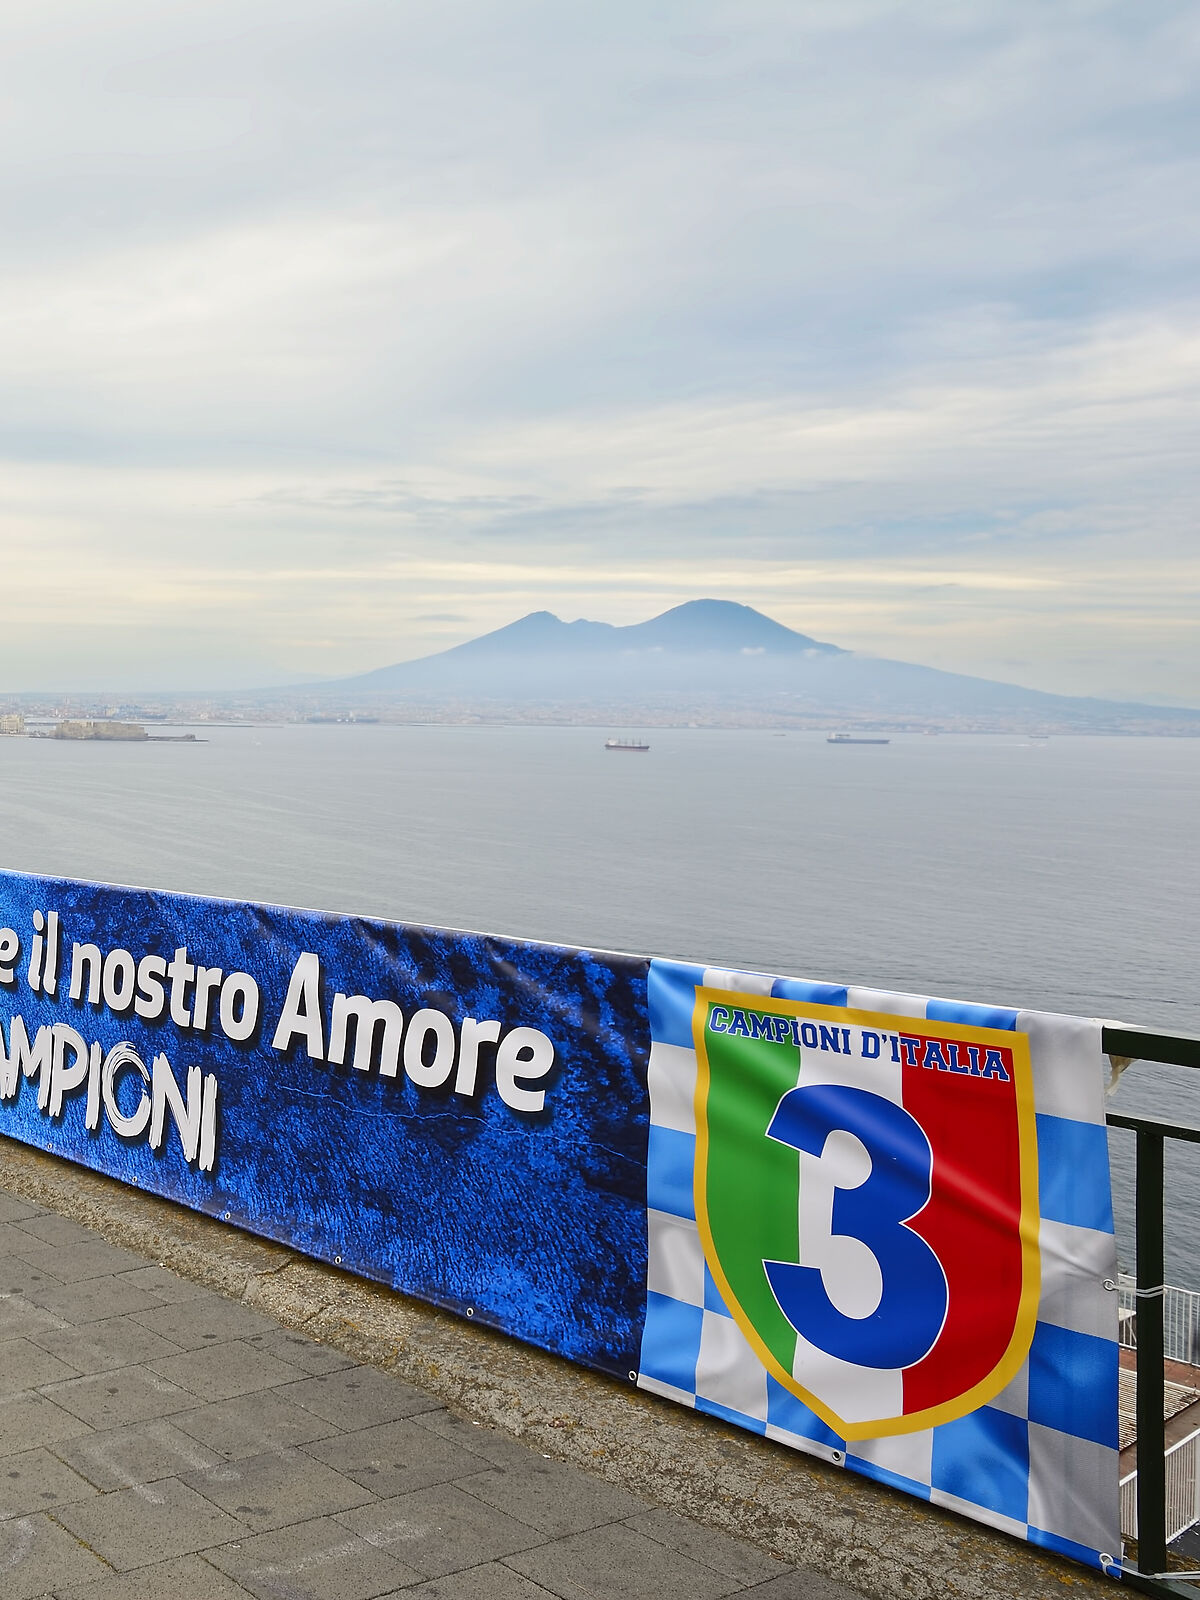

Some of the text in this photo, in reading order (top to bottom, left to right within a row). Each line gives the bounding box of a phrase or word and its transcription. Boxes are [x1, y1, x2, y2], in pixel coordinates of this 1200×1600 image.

[28, 910, 58, 994] il
[69, 943, 260, 1041] nostro
[271, 952, 555, 1112] Amore
[709, 1006, 1010, 1082] CAMPIONI D'ITALIA
[762, 1084, 949, 1370] 3
